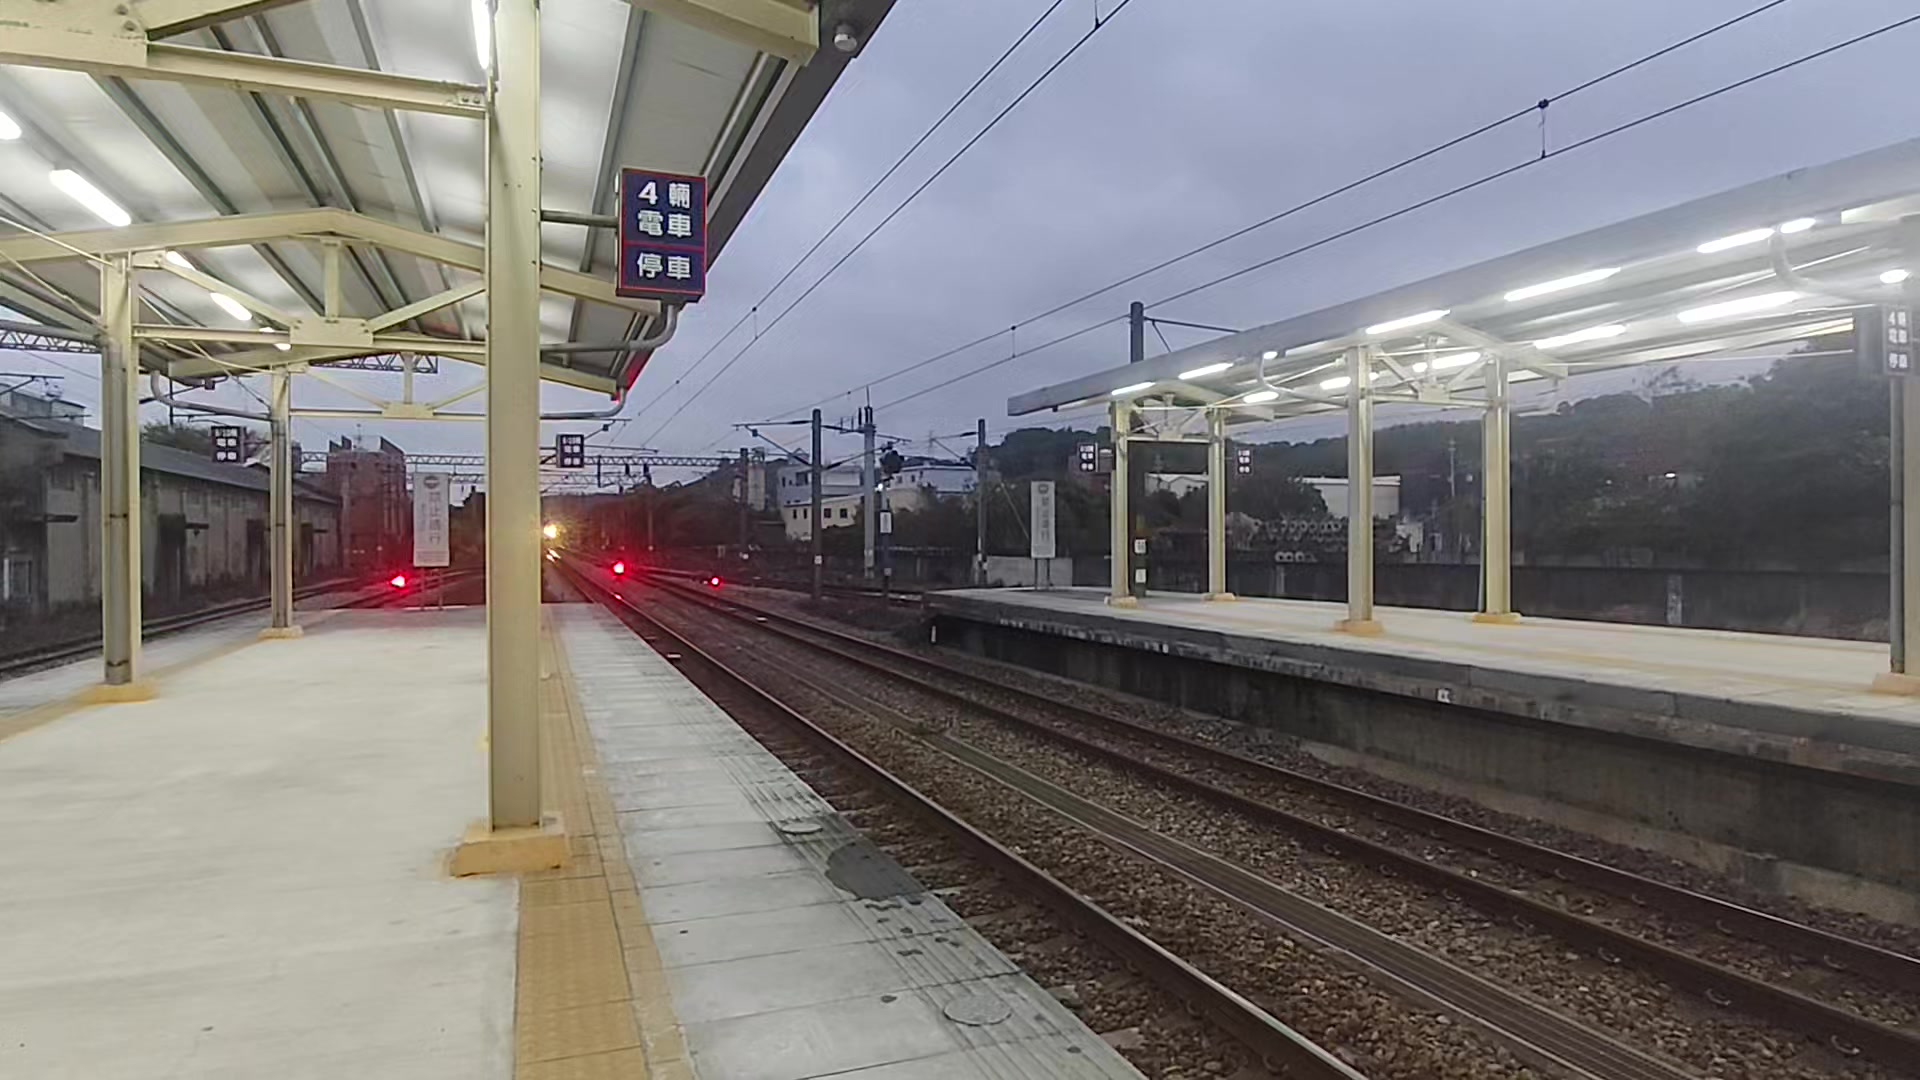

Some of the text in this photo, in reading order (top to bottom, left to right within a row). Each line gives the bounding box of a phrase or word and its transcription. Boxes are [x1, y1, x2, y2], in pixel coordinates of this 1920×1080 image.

[638, 181, 690, 209] 4輛
[637, 209, 692, 238] 電車
[637, 252, 692, 280] 停車
